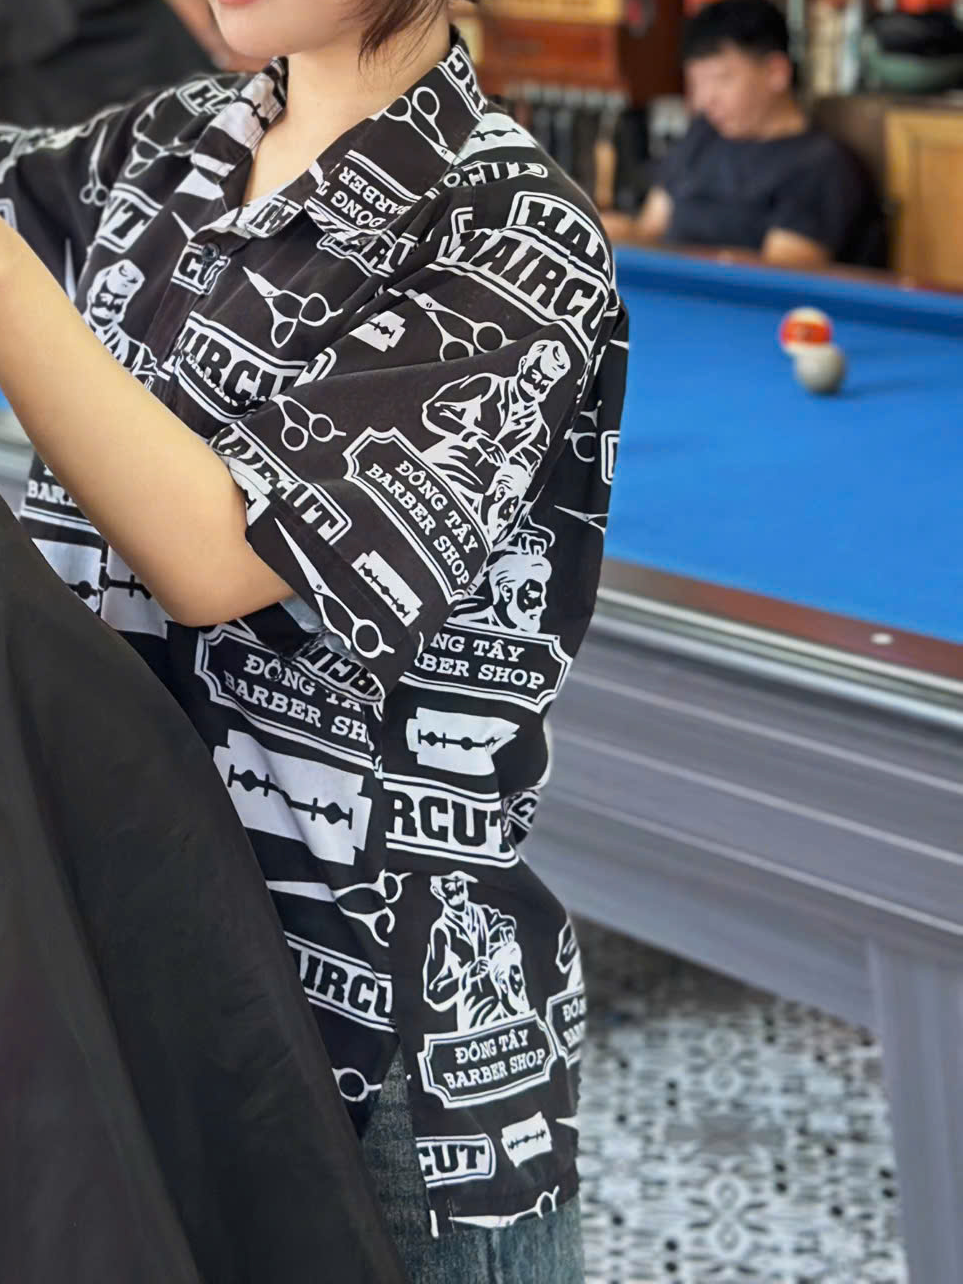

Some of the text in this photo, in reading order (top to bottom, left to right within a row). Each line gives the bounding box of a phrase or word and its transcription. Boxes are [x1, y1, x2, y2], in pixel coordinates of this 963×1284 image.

[330, 190, 387, 228] ĐÔNG
[338, 166, 412, 215] BARBER
[365, 463, 470, 586] BARBER SHOP
[394, 460, 479, 554] ĐÔNG TÂY
[414, 653, 545, 690] BER SHOP
[473, 638, 525, 663] TÂY
[243, 653, 316, 696] ĐÔNG
[224, 670, 322, 728] BARBER
[331, 715, 374, 752] SH
[454, 1028, 529, 1064] ĐÔNG TÂY
[442, 1048, 546, 1090] BARBER SHOP
